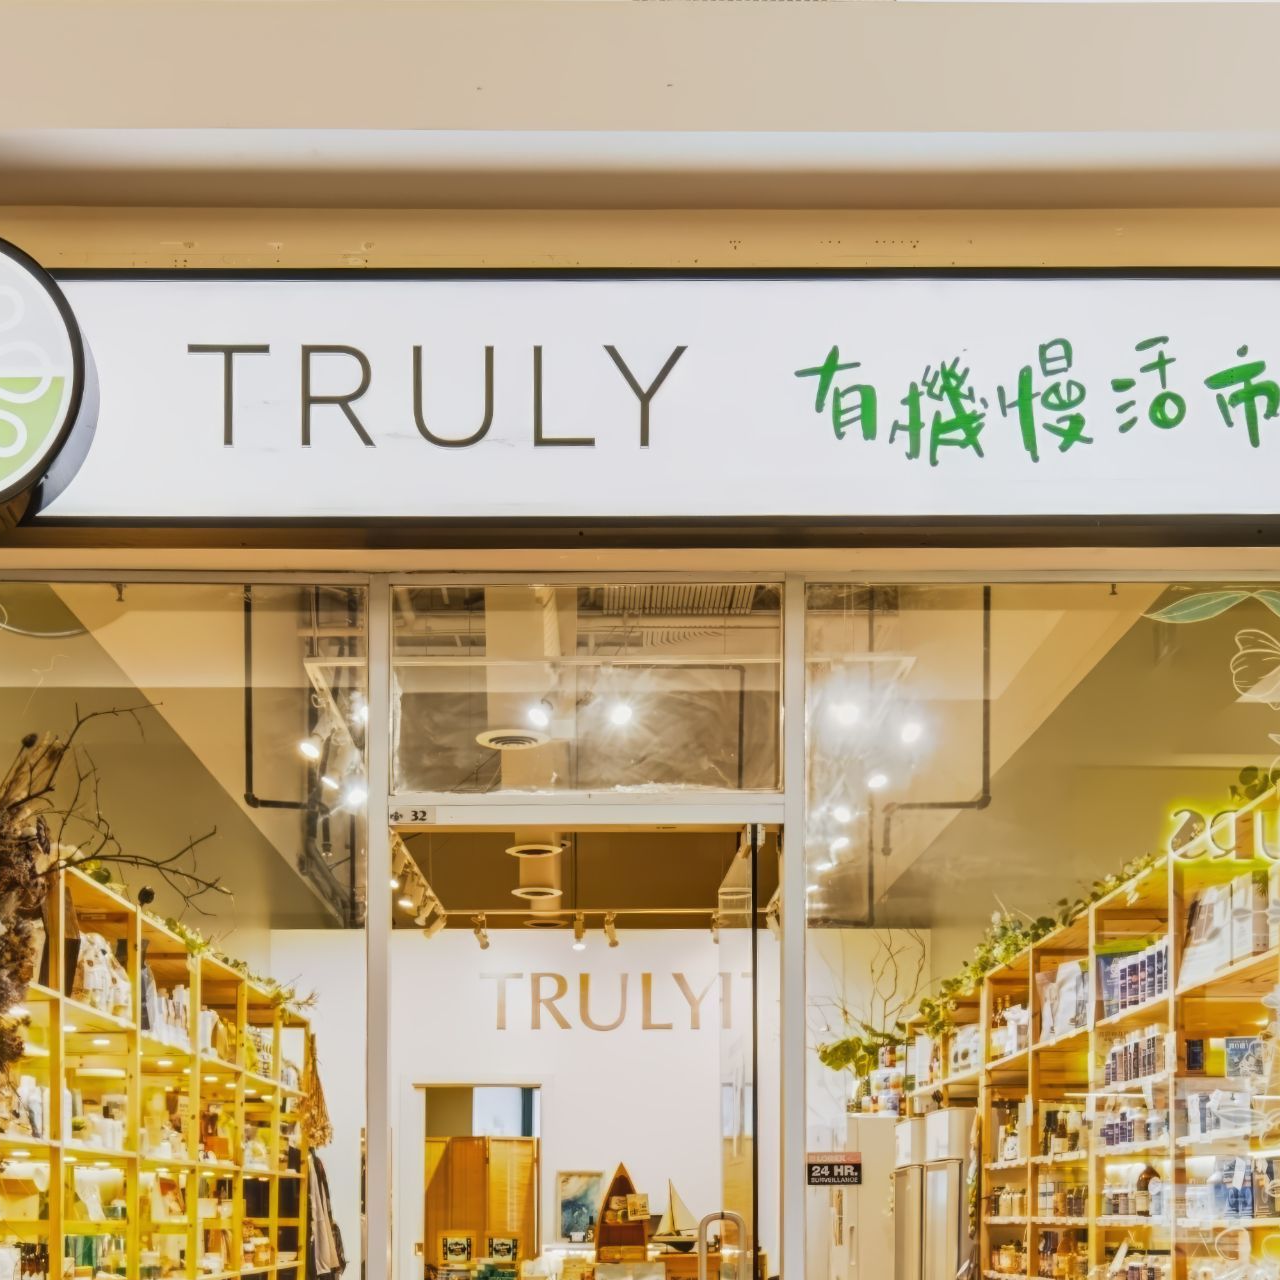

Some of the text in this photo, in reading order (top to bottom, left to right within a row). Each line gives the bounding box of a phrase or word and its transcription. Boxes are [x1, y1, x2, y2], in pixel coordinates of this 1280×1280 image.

[187, 344, 688, 448] TRULY
[410, 810, 427, 821] 32
[479, 972, 720, 1032] TRULY
[811, 1165, 858, 1177] 24 HR.
